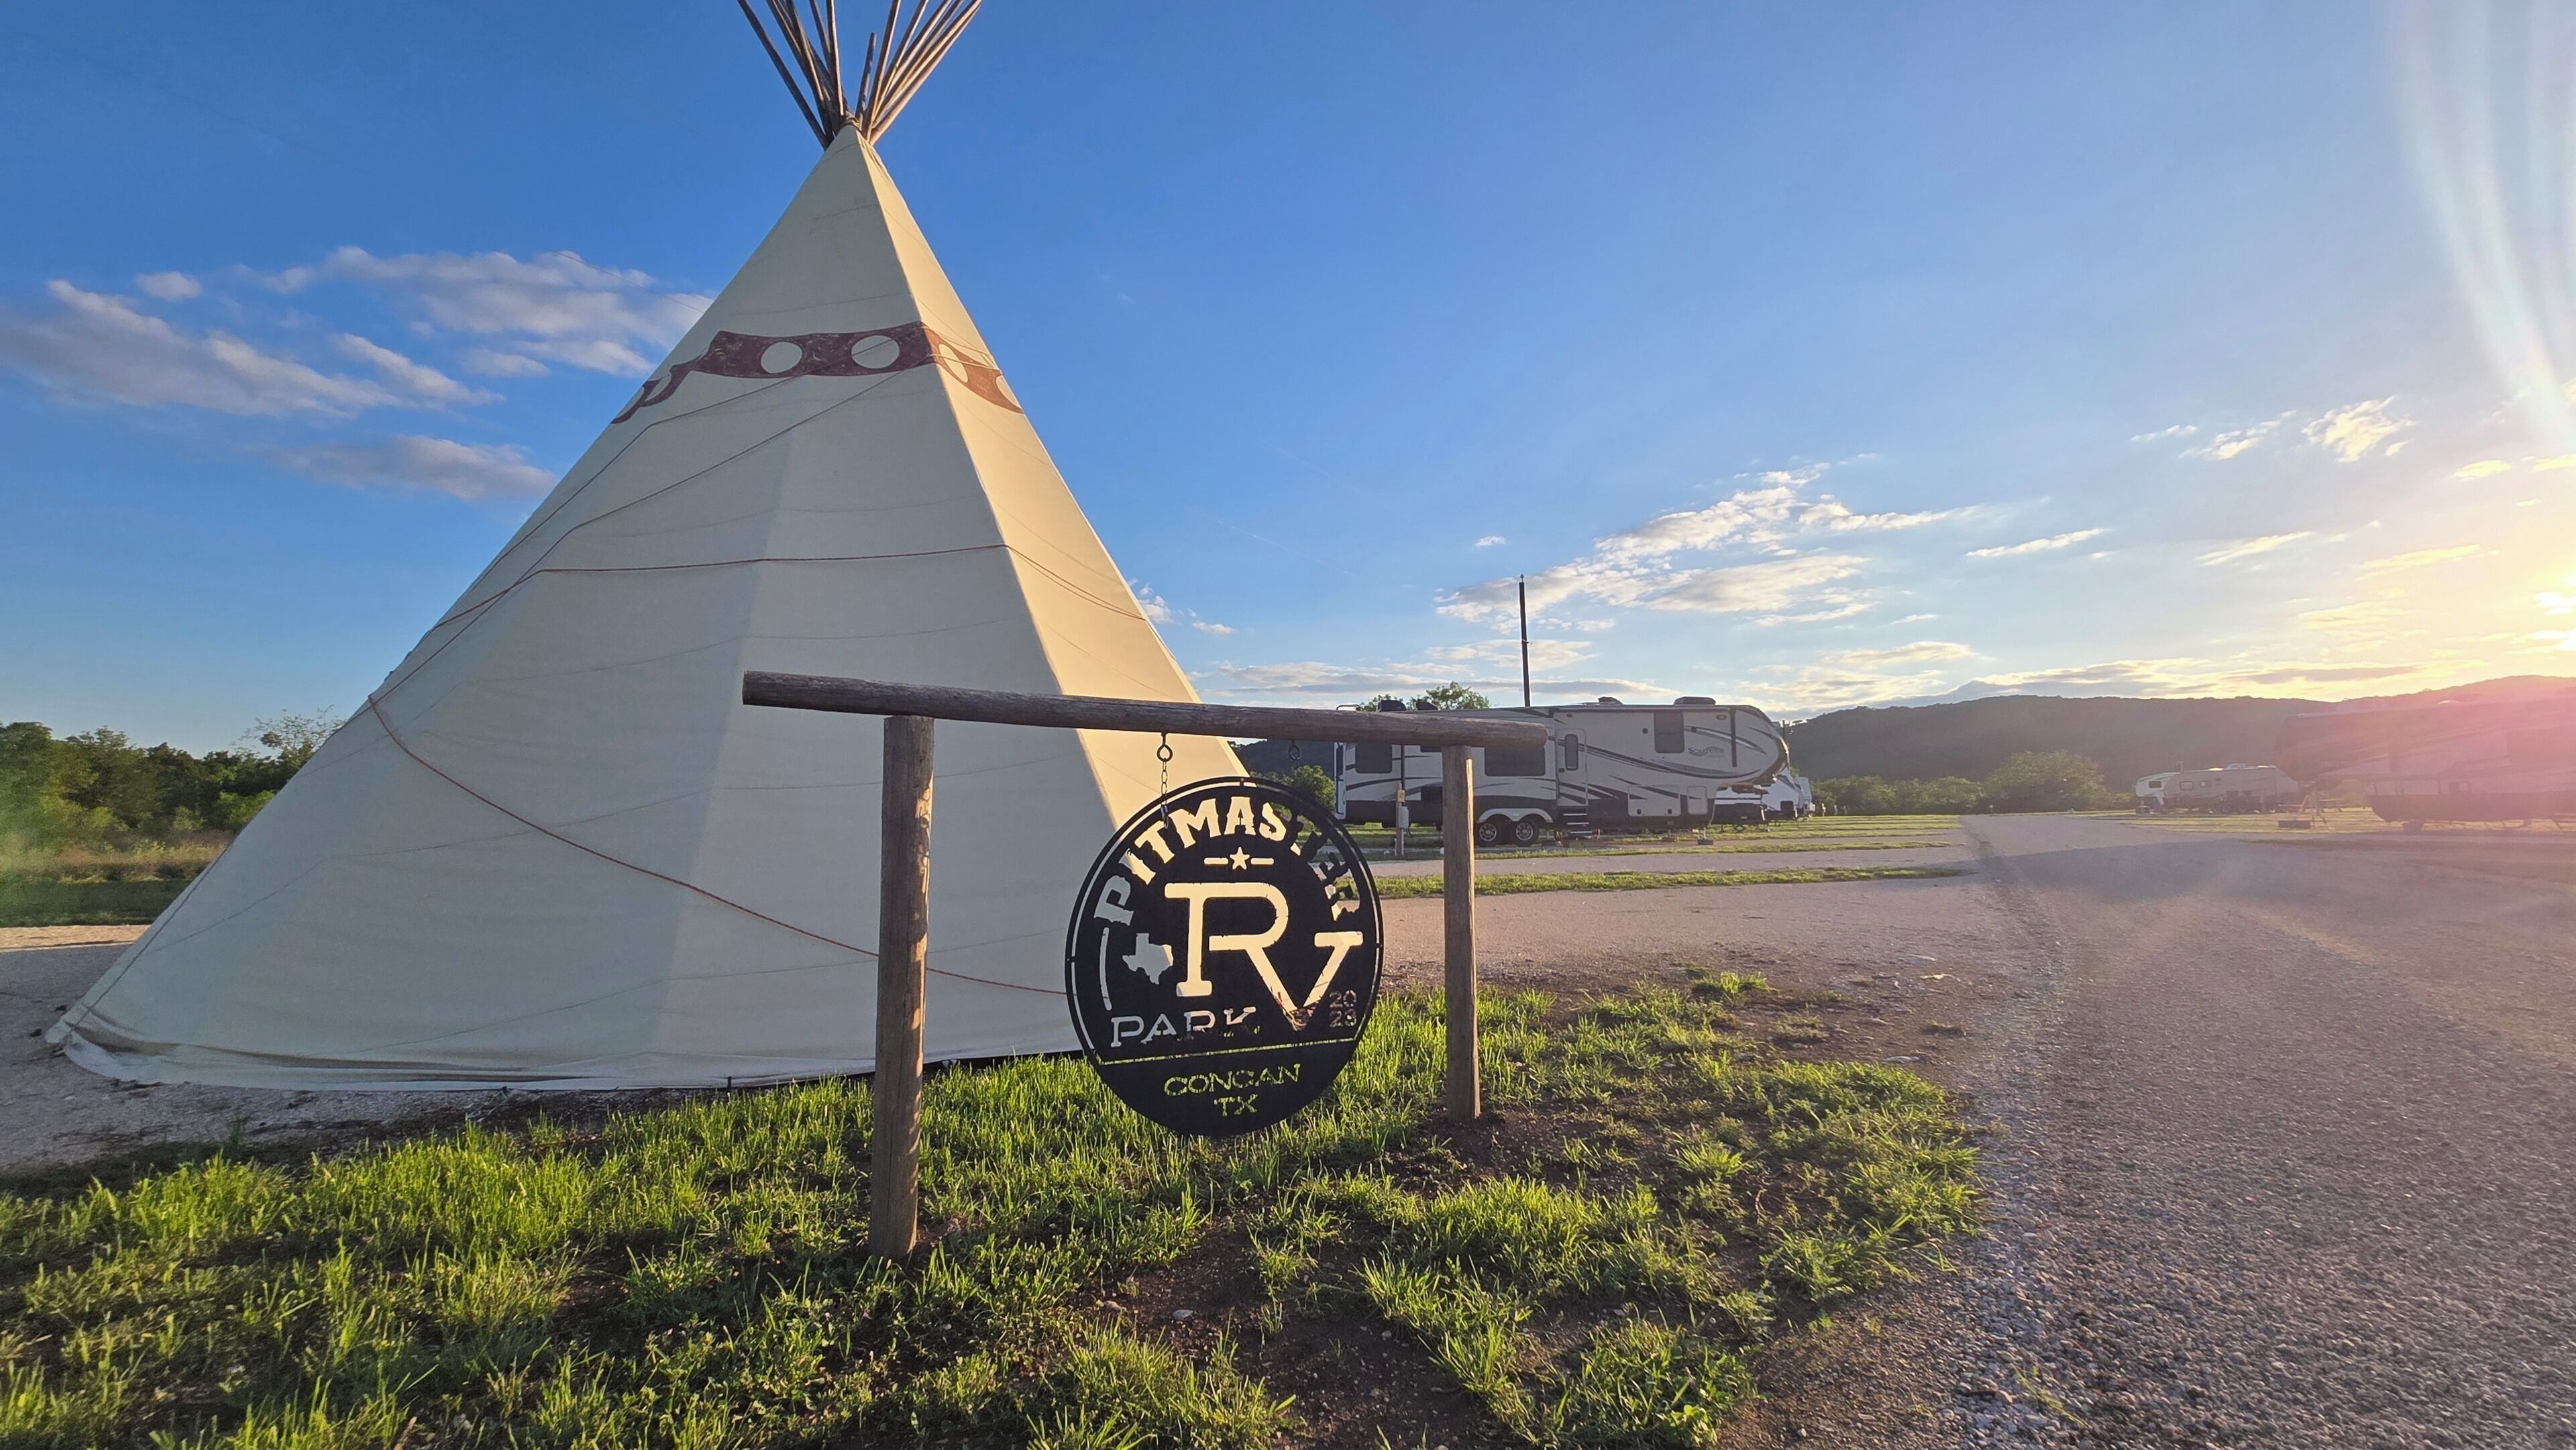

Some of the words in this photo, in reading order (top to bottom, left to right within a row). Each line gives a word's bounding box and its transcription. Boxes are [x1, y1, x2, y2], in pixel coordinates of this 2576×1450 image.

[1093, 796, 1360, 925] PITMASTER
[1165, 882, 1363, 1031] RV
[1110, 1006, 1260, 1047] PARK
[1164, 1064, 1301, 1095] CONCAN
[1214, 1094, 1258, 1117] TX
